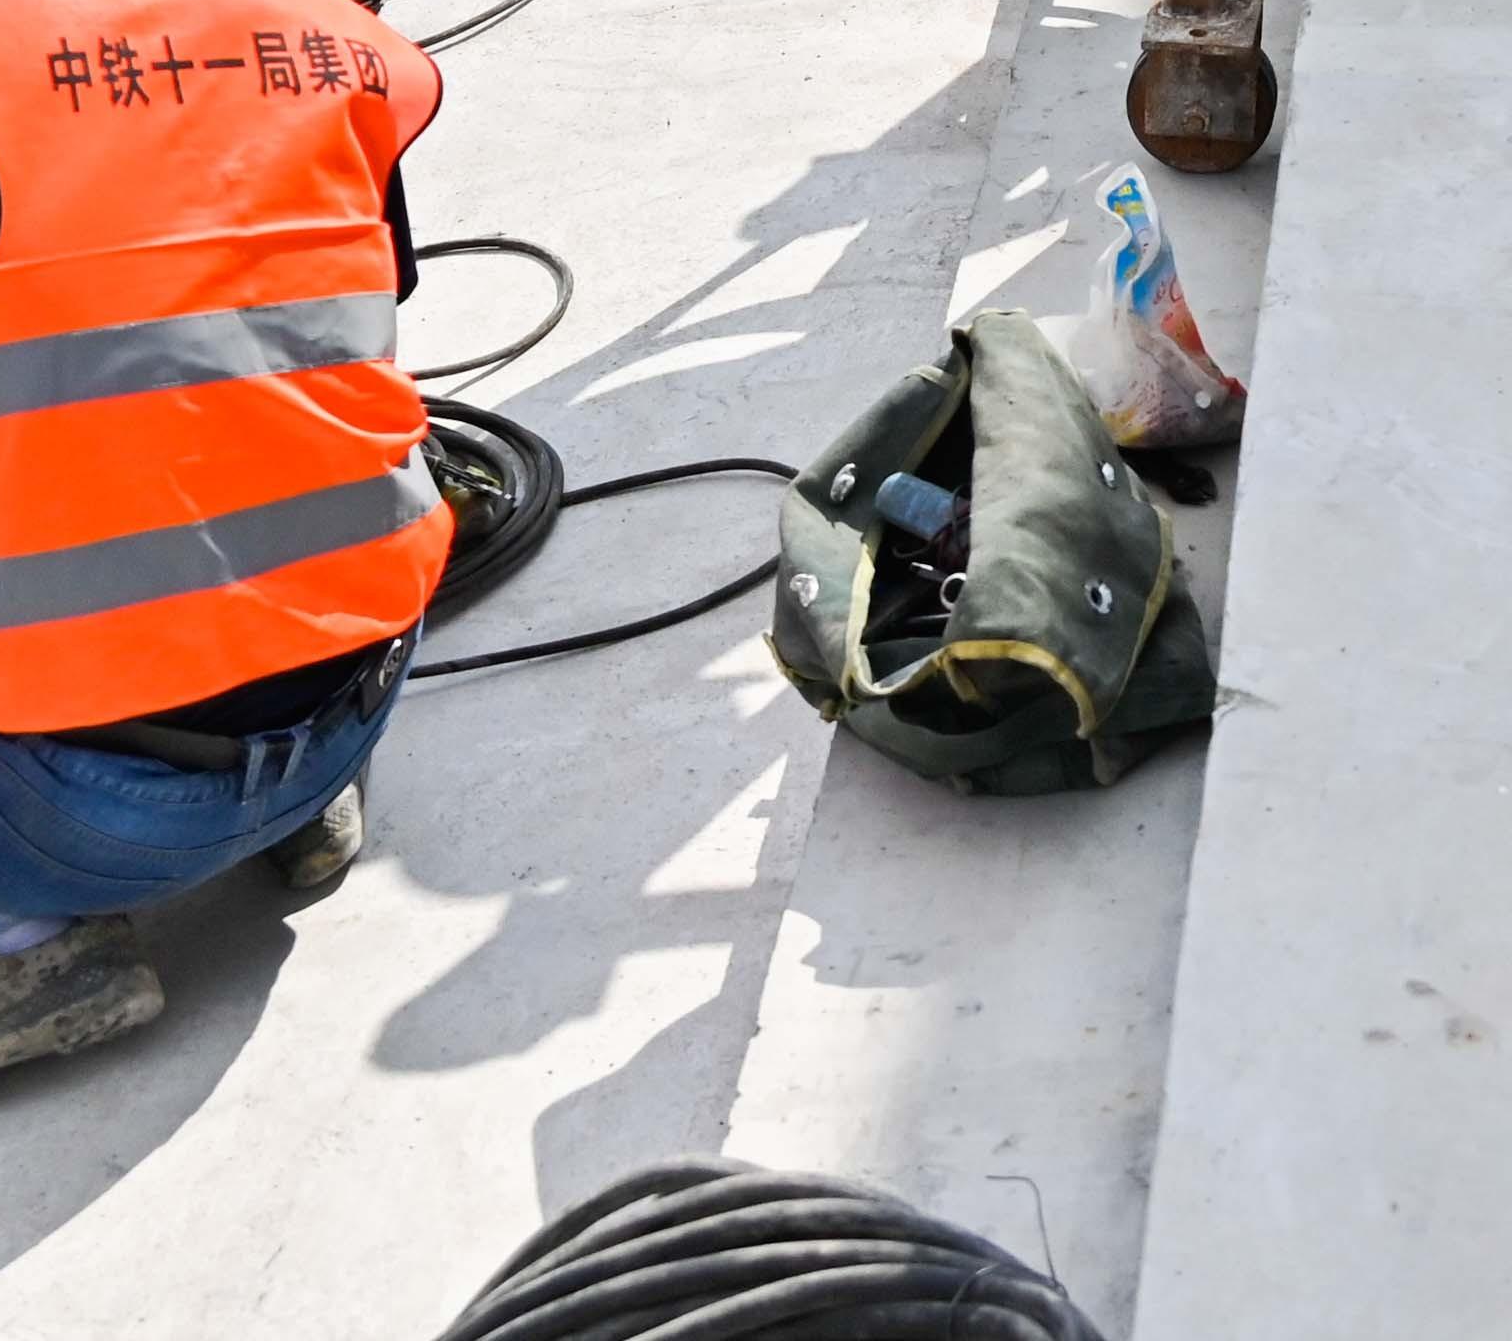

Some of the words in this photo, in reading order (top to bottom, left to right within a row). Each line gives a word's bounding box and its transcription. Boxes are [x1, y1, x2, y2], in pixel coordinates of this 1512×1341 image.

[47, 28, 389, 113] 中铁十一局集团
